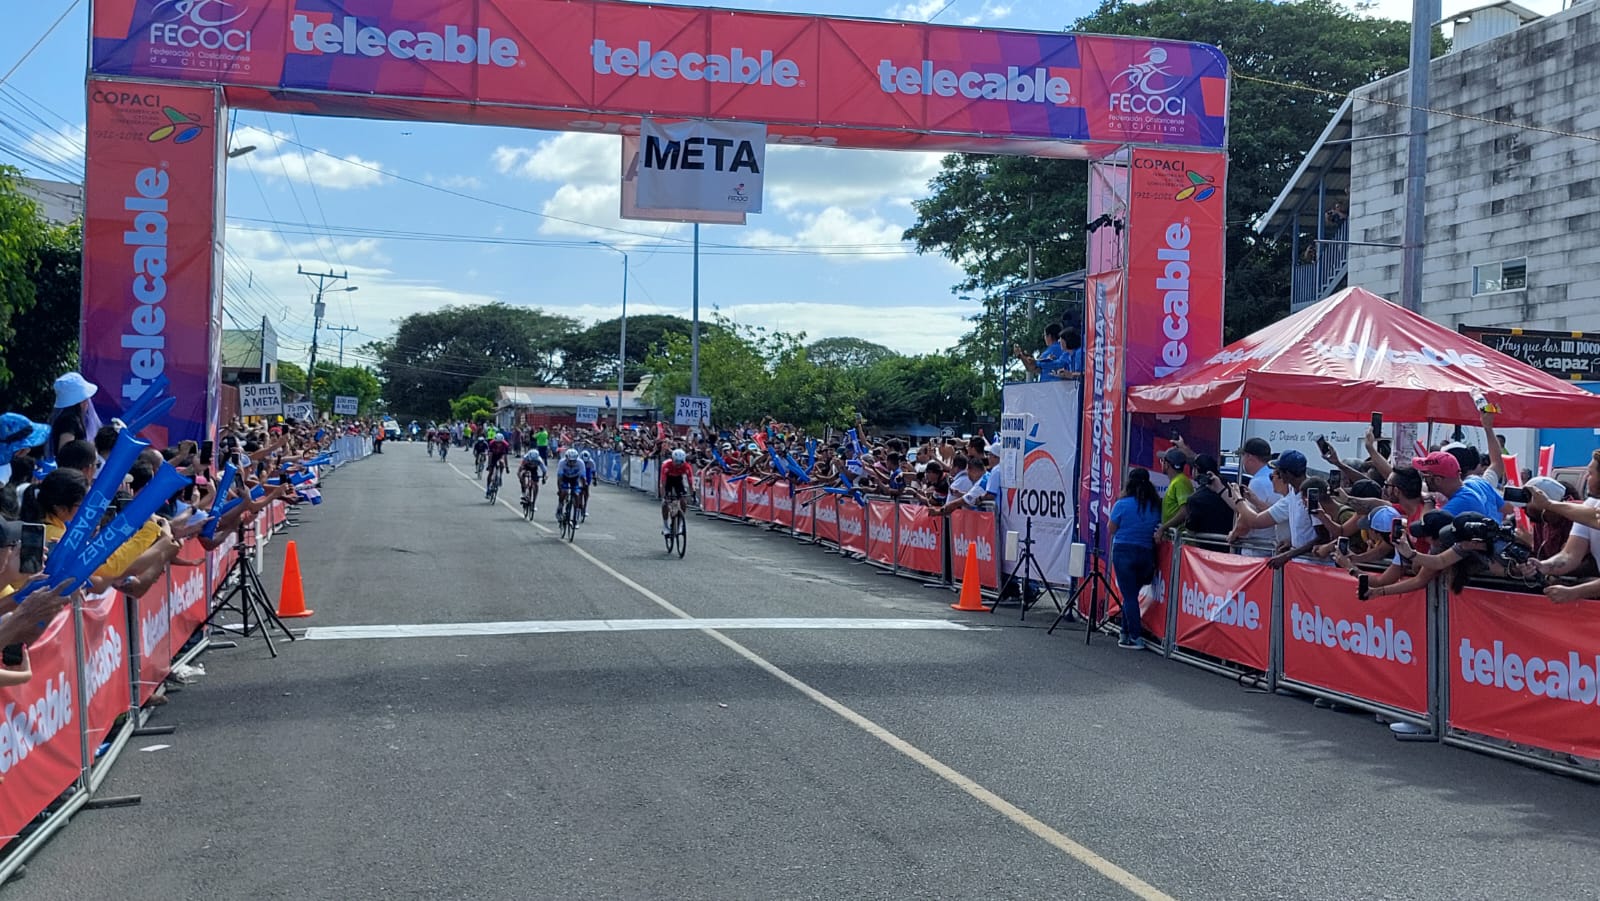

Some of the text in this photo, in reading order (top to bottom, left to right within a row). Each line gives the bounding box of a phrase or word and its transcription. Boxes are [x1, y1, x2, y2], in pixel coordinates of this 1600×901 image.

[150, 22, 251, 52] FECOCI
[291, 14, 519, 67] telecable
[181, 58, 250, 70] Ciclismo
[590, 39, 800, 88] telecable
[877, 60, 1071, 105] telecable
[92, 90, 160, 107] COPACI
[1109, 93, 1186, 116] FECOCI
[1132, 123, 1185, 132] Ciclismo
[644, 135, 760, 173] META
[1134, 158, 1184, 171] COPACI
[1523, 341, 1541, 359] que
[1542, 337, 1560, 353] dar
[1561, 340, 1574, 353] un
[1577, 341, 1600, 355] poco
[1545, 357, 1588, 372] capaz
[244, 386, 276, 396] 50 mts
[243, 396, 280, 407] A META
[680, 398, 690, 408] 50
[677, 409, 709, 418] A MEA
[1002, 417, 1025, 432] CONTROL
[1002, 437, 1021, 451] DOPING
[1091, 401, 1102, 494] MEJOR
[1017, 489, 1067, 519] ICODER
[1182, 581, 1259, 630] telecable
[1290, 603, 1412, 664] telecable
